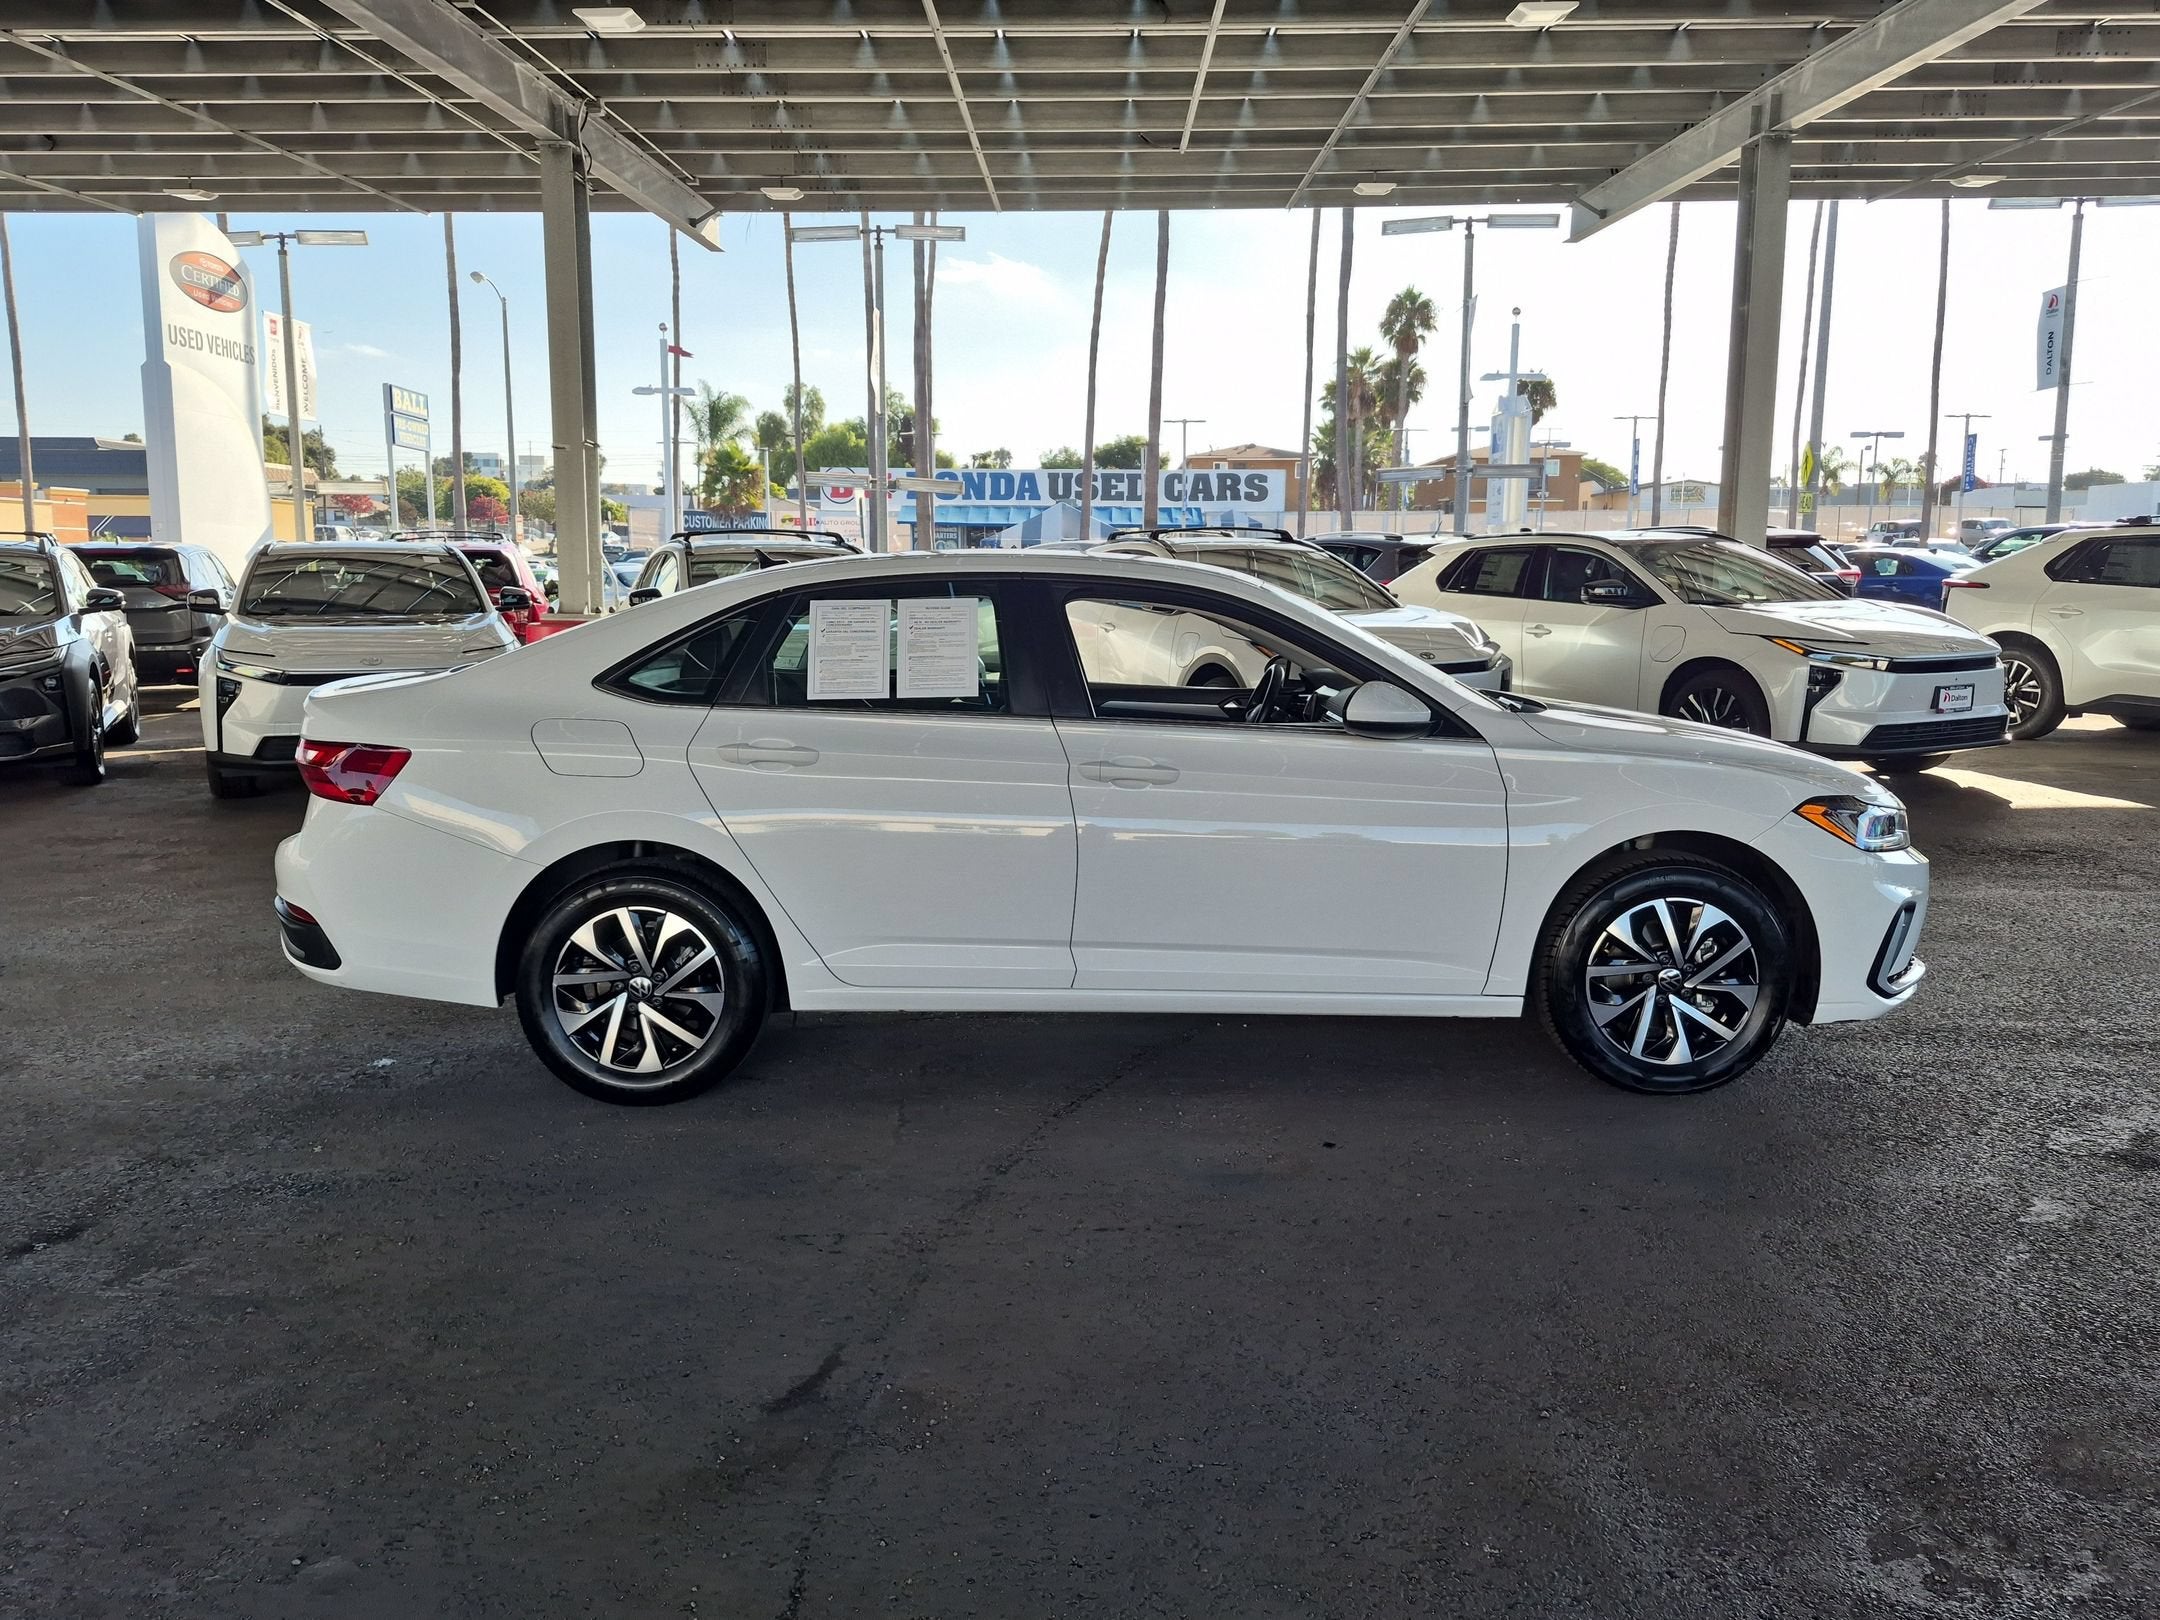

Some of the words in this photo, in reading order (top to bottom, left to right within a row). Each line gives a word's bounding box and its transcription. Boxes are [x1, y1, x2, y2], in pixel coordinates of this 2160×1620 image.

[181, 264, 240, 297] CERTIFIED
[167, 323, 204, 352] USED
[206, 333, 255, 366] VEHICLES
[2045, 331, 2055, 375] DALTON
[301, 356, 309, 413] WELCOME
[394, 389, 428, 418] BALL
[1047, 472, 1144, 501] USED
[1164, 472, 1269, 502] CARS
[793, 517, 817, 527] Bll
[1951, 693, 1968, 702] Dalton
